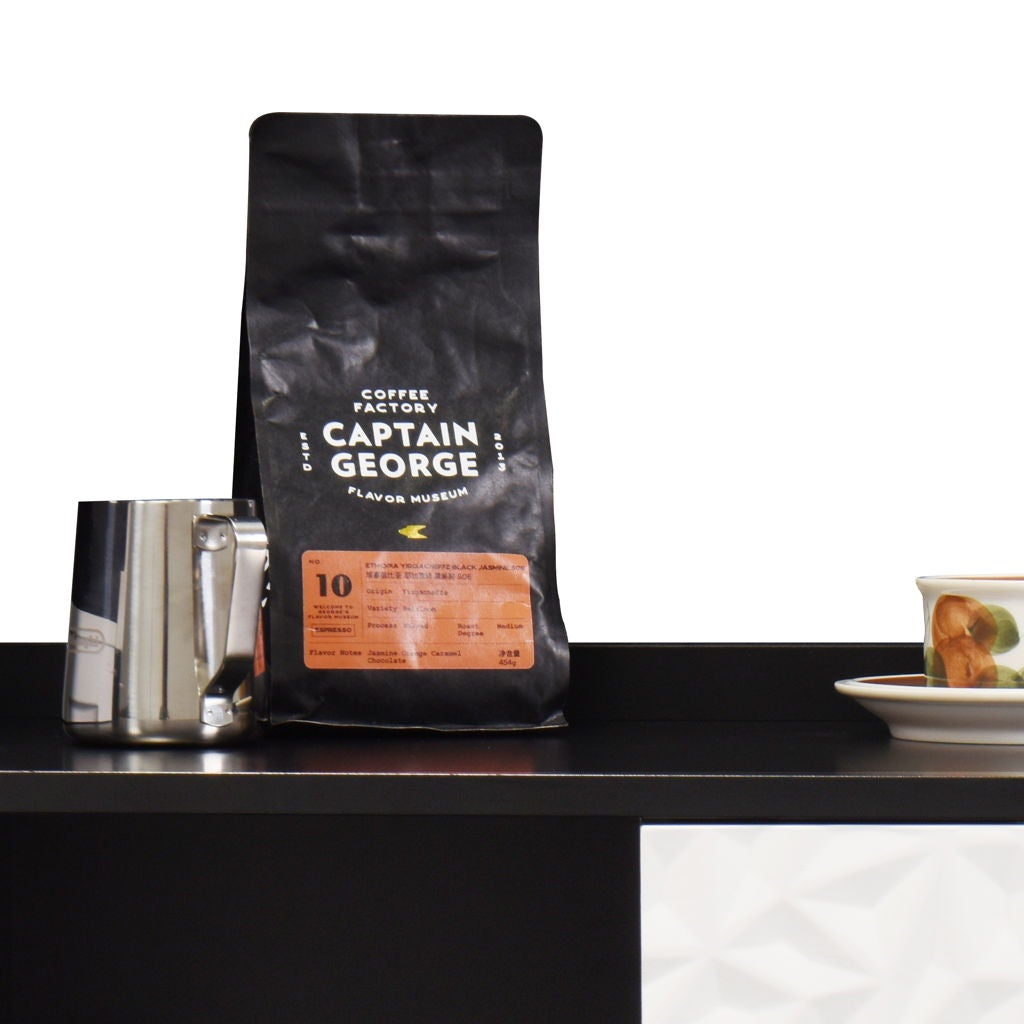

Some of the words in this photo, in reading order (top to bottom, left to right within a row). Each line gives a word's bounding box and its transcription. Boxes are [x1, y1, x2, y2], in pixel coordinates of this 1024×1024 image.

[361, 389, 430, 400] COFFEE
[353, 402, 438, 414] FACTORY
[322, 421, 479, 447] CAPTAIN
[299, 431, 313, 472] ESTD
[331, 452, 480, 478] GEORGE
[347, 486, 406, 504] FLAVOR
[411, 486, 468, 504] MUSEUM
[451, 563, 477, 571] BLACK
[315, 573, 353, 598] 10
[366, 588, 393, 596] Origin
[367, 605, 398, 613] Variety
[457, 630, 484, 638] Degree
[340, 649, 362, 657] Notes
[367, 649, 398, 657] Jasmine
[498, 658, 517, 667] 454g
